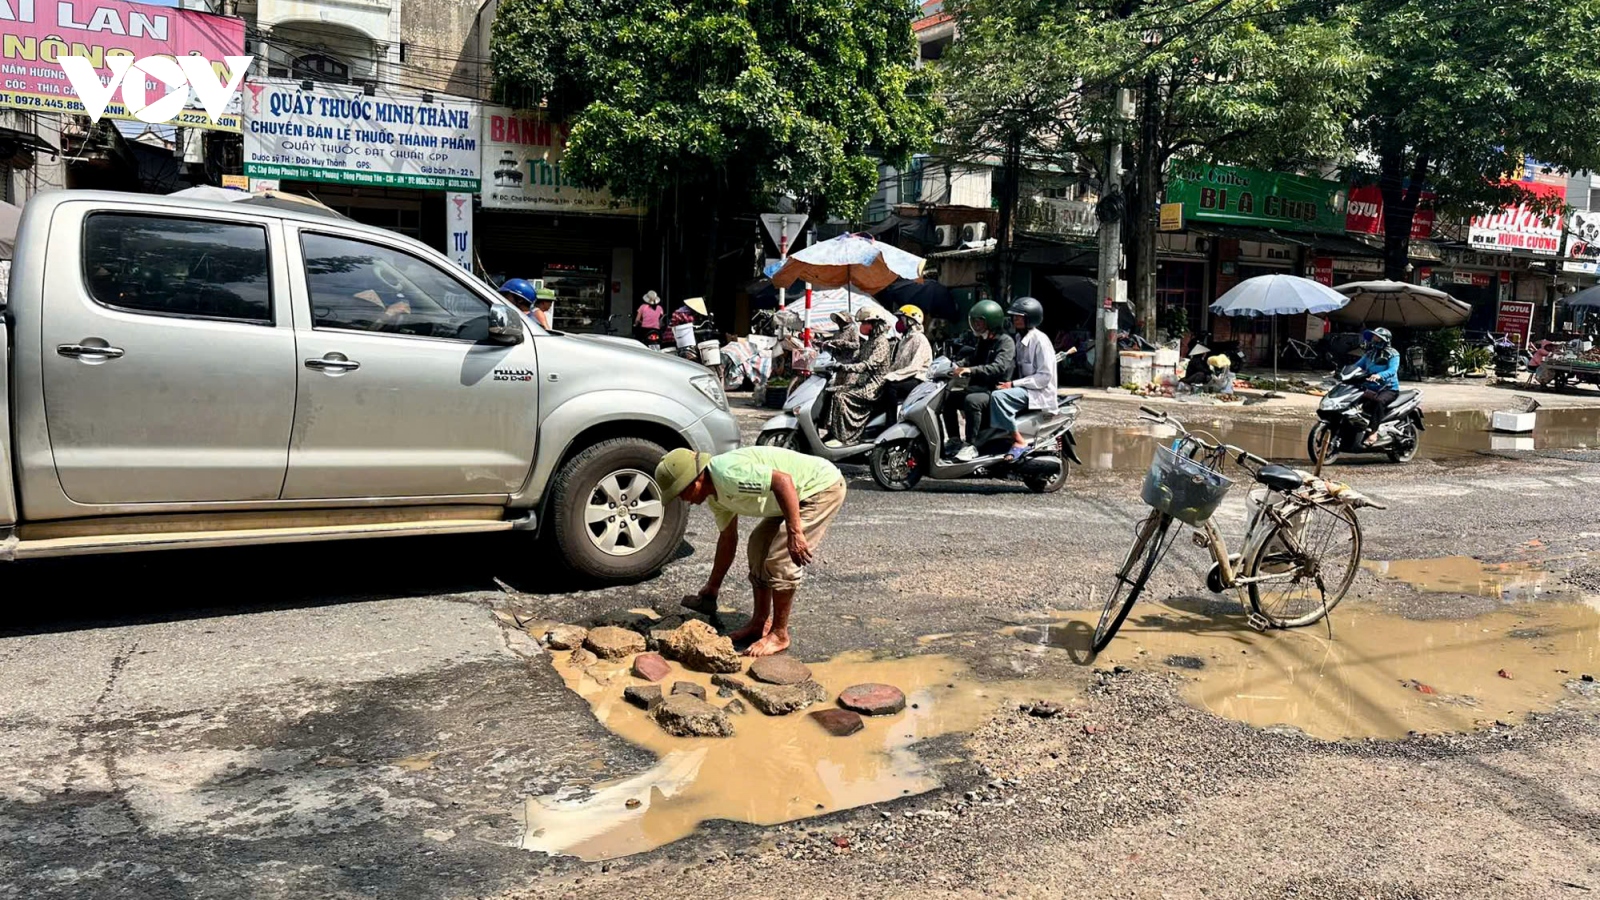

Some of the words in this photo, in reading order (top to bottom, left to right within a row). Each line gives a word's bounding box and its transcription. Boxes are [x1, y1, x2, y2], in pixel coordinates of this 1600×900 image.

[57, 1, 168, 41] LAN
[15, 95, 86, 111] 0978.445.885
[319, 92, 371, 120] THUỐC
[375, 102, 414, 125] MINH
[418, 103, 469, 129] THÀNH
[251, 120, 302, 137] CHUYÊN
[307, 124, 333, 139] BÁN
[337, 123, 351, 141] LẺ
[355, 128, 394, 144] THUỐC
[398, 132, 437, 148] THÀNH
[441, 134, 476, 151] PHẨM
[490, 112, 552, 146] BÁNH
[312, 157, 325, 166] Huy
[429, 152, 449, 162] GPP
[1200, 187, 1253, 214] BI-A
[453, 230, 468, 252] TƯ
[1501, 304, 1530, 313] MOTUL
